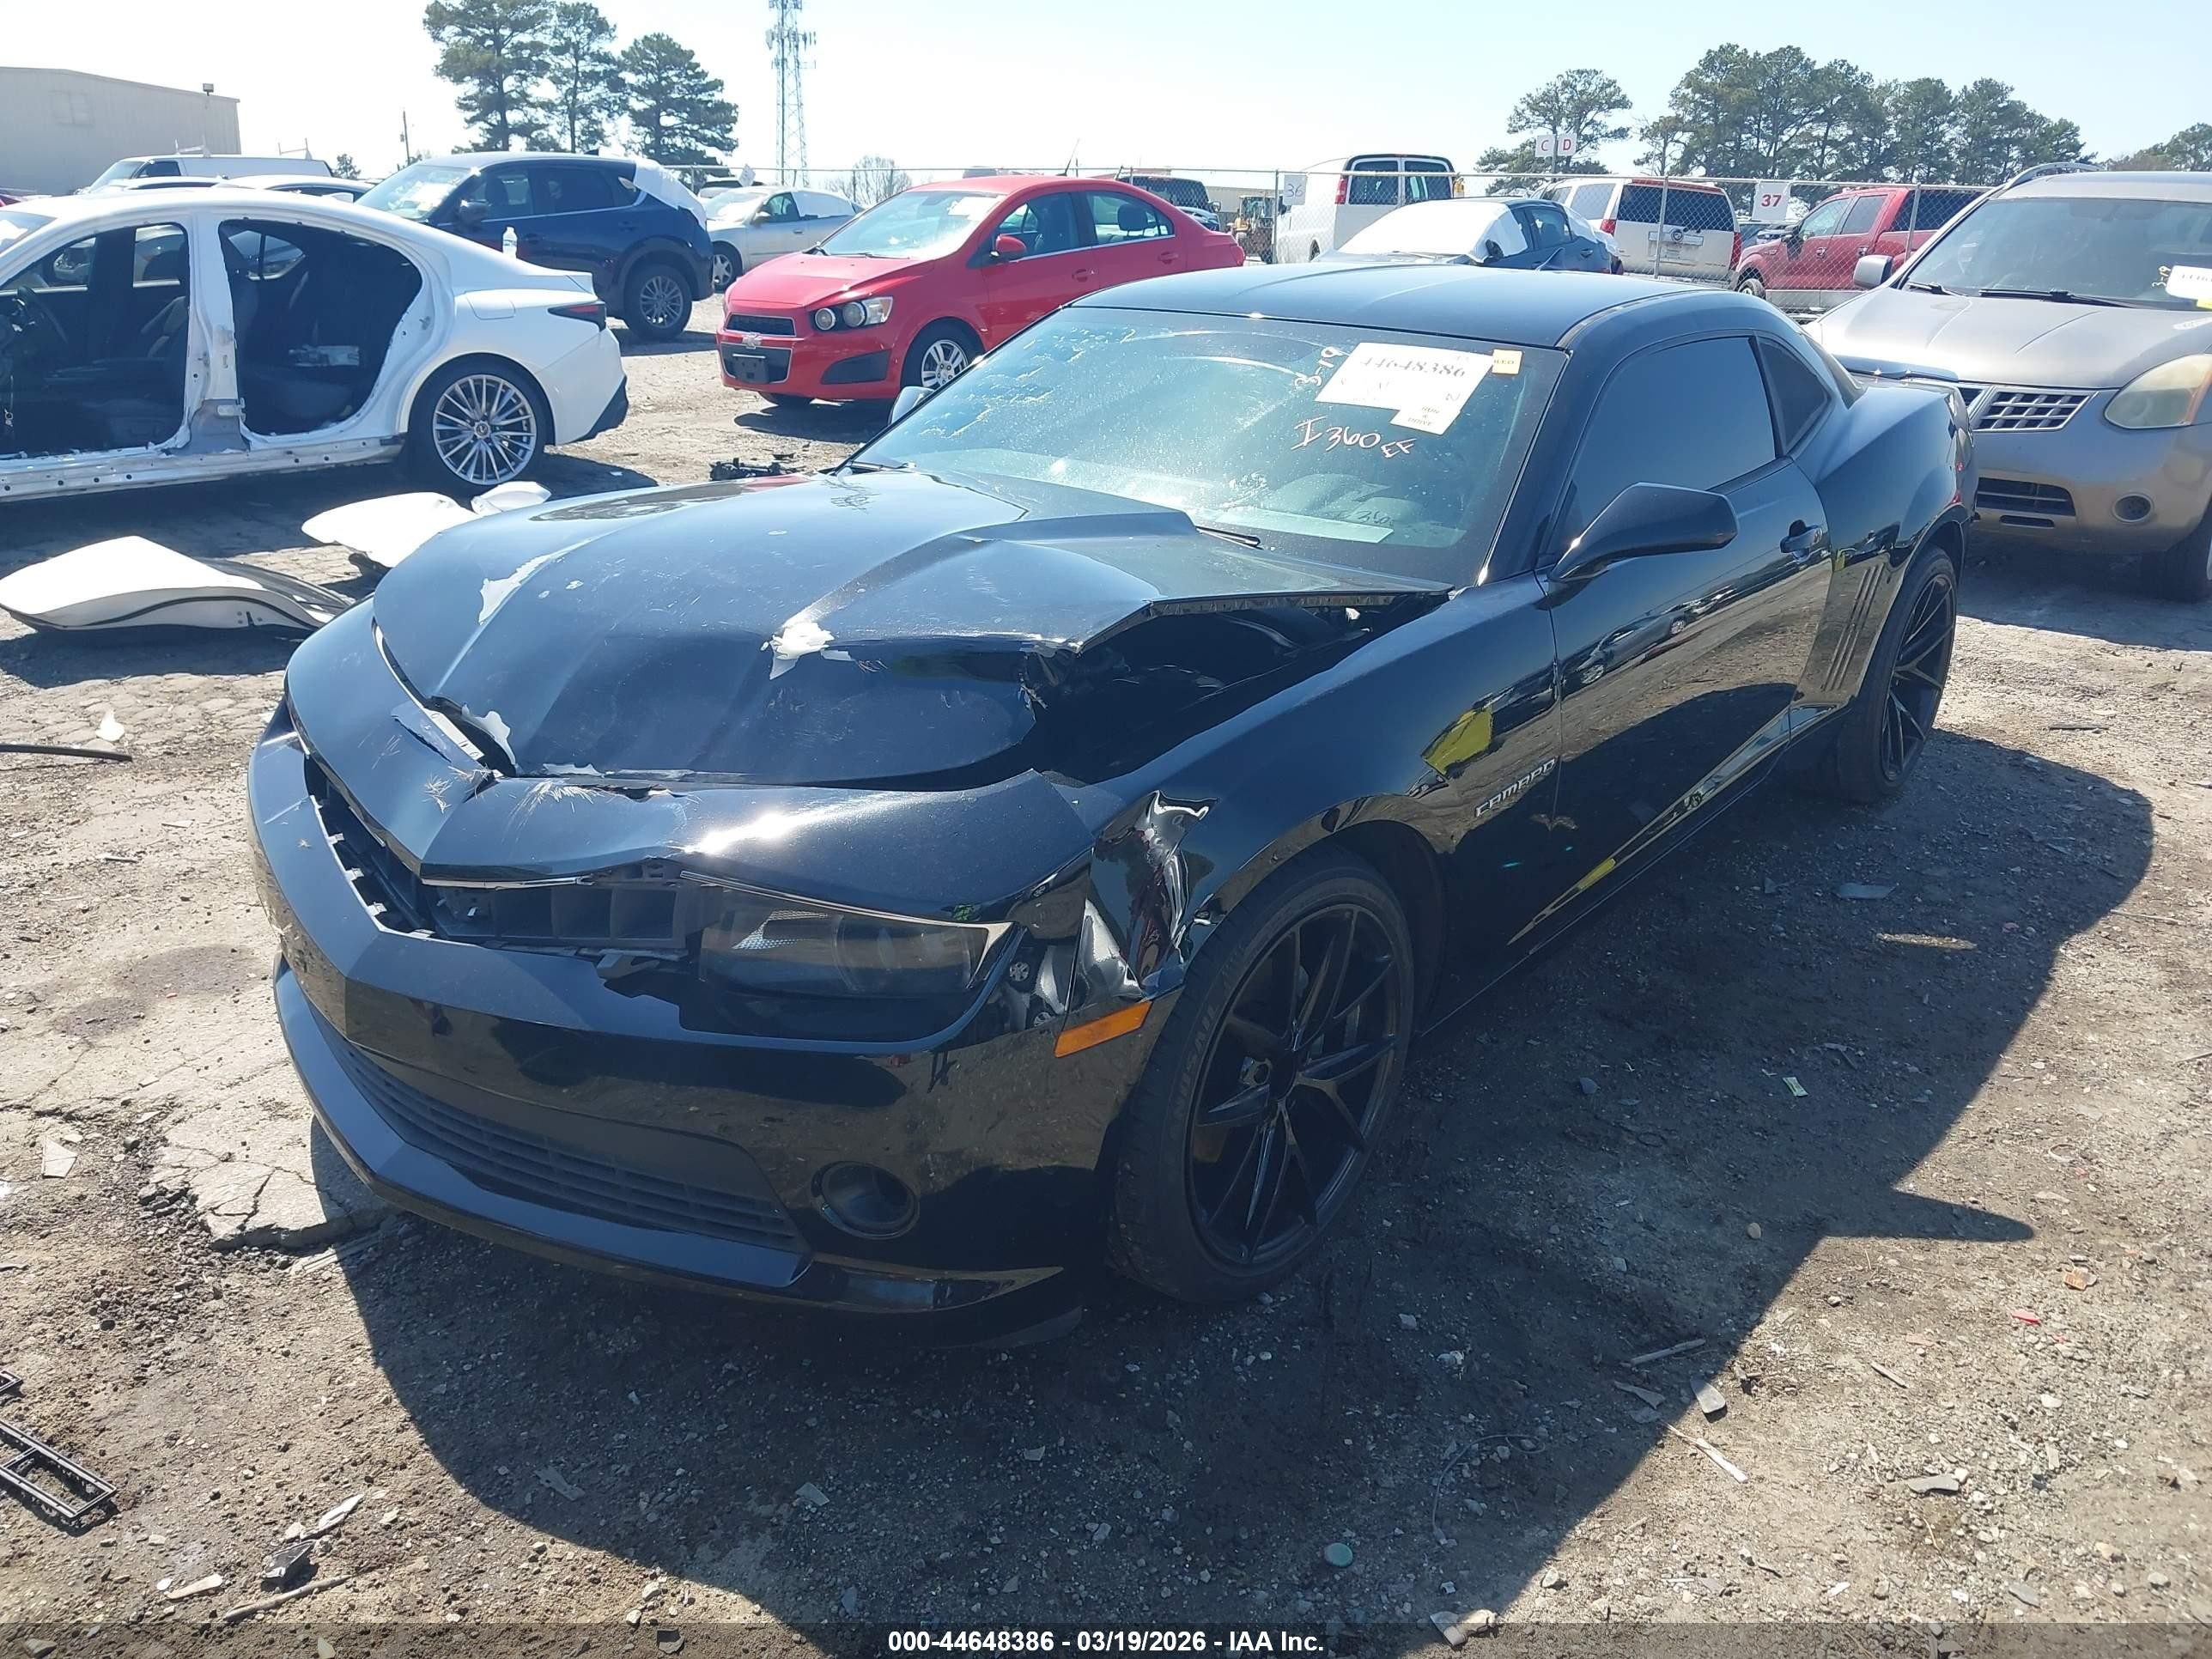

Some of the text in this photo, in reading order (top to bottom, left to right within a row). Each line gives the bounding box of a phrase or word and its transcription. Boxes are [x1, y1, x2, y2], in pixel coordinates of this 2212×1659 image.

[1541, 139, 1549, 151] C
[1563, 139, 1571, 150] D
[1286, 182, 1304, 198] 36
[1761, 194, 1782, 207] 37
[1294, 347, 1345, 388] 3-19
[1475, 758, 1556, 817] CAMARO
